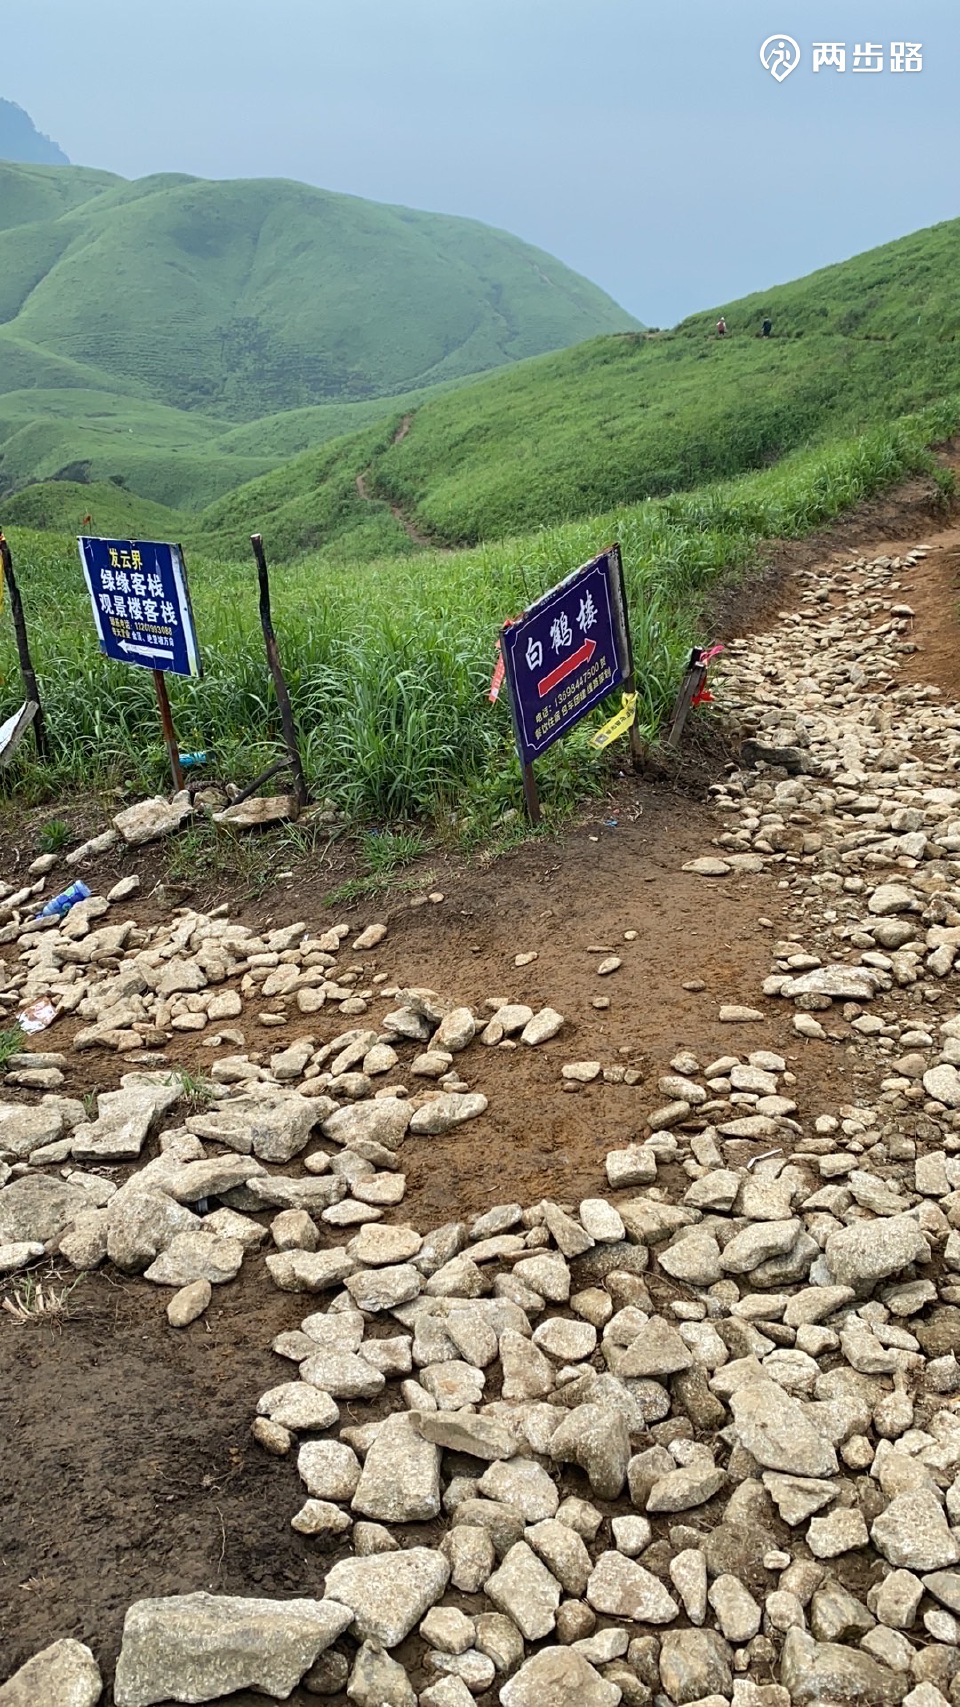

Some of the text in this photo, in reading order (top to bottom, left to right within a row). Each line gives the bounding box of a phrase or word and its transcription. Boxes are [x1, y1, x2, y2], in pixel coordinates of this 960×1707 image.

[109, 547, 143, 571] 发云界
[100, 568, 165, 598] 绿缘客栈
[98, 593, 178, 626] 观景楼客栈
[525, 589, 599, 671] 白鹤楼
